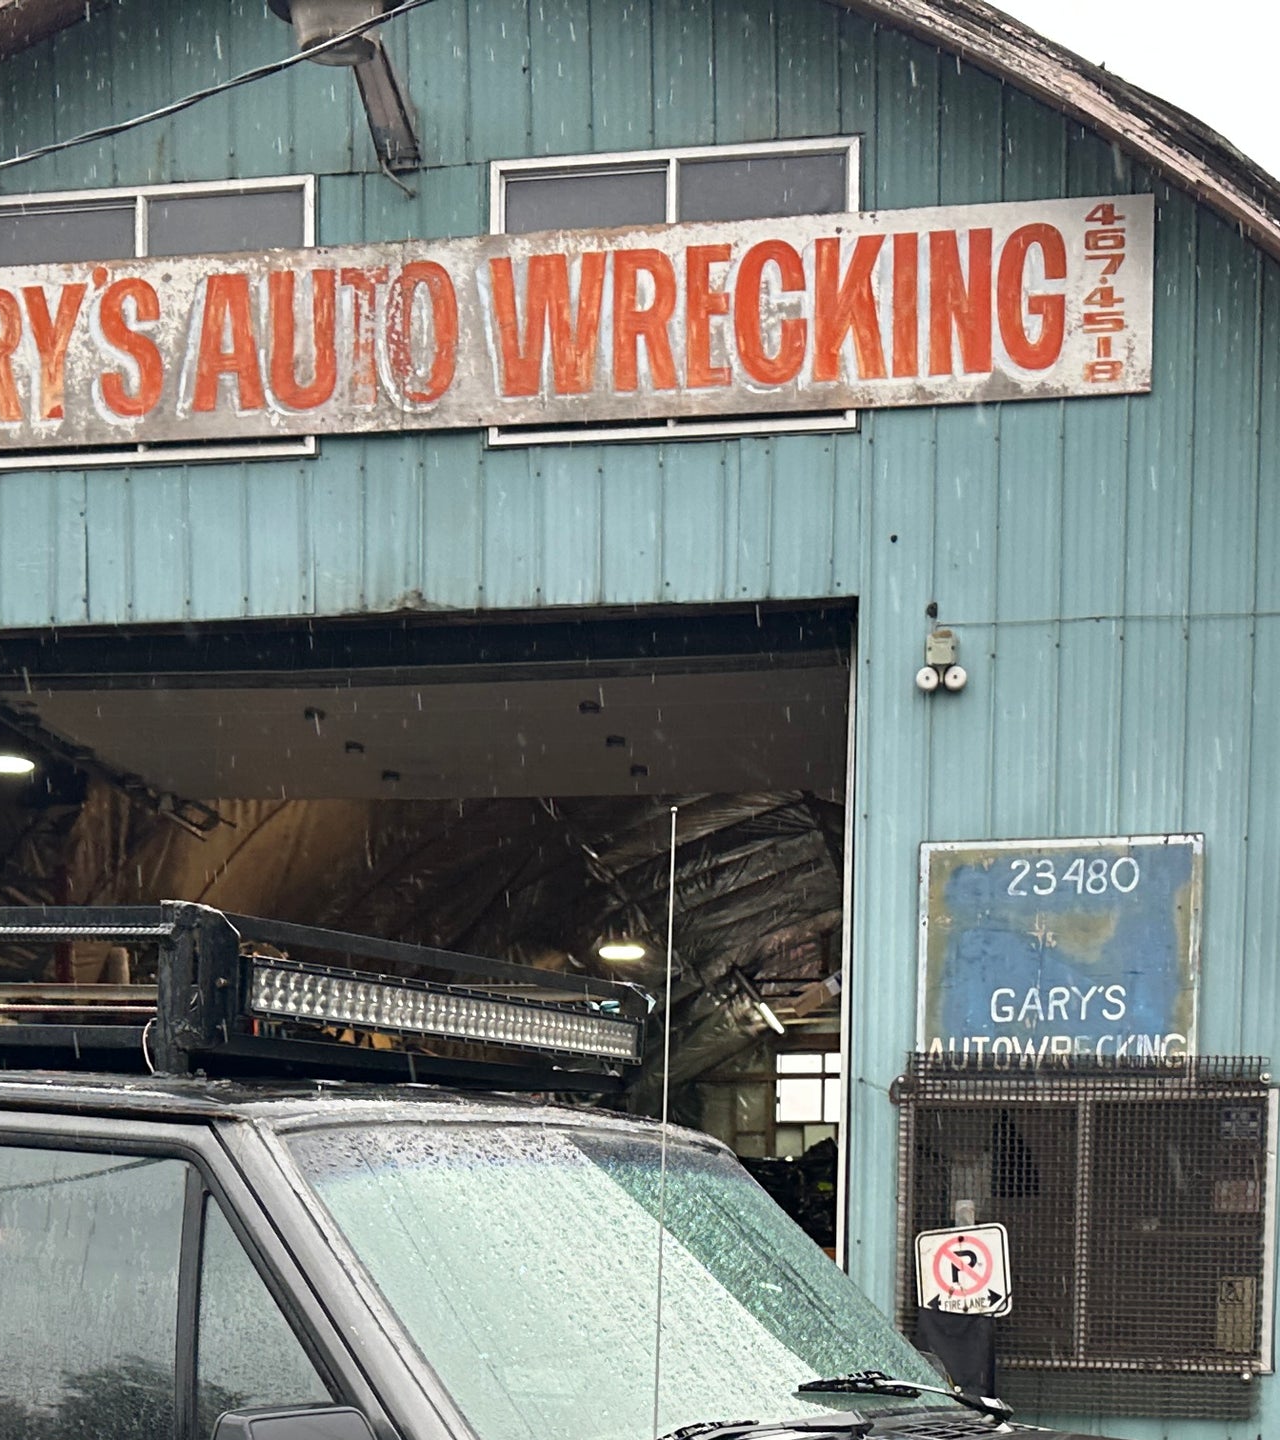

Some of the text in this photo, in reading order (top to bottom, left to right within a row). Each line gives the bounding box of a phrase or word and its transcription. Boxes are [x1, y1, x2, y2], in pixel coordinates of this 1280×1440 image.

[190, 260, 460, 414] AUTO
[486, 222, 1068, 398] WRECKING
[1007, 857, 1140, 896] 23480
[990, 984, 1126, 1023] GARY'S
[944, 1299, 961, 1310] FIRE
